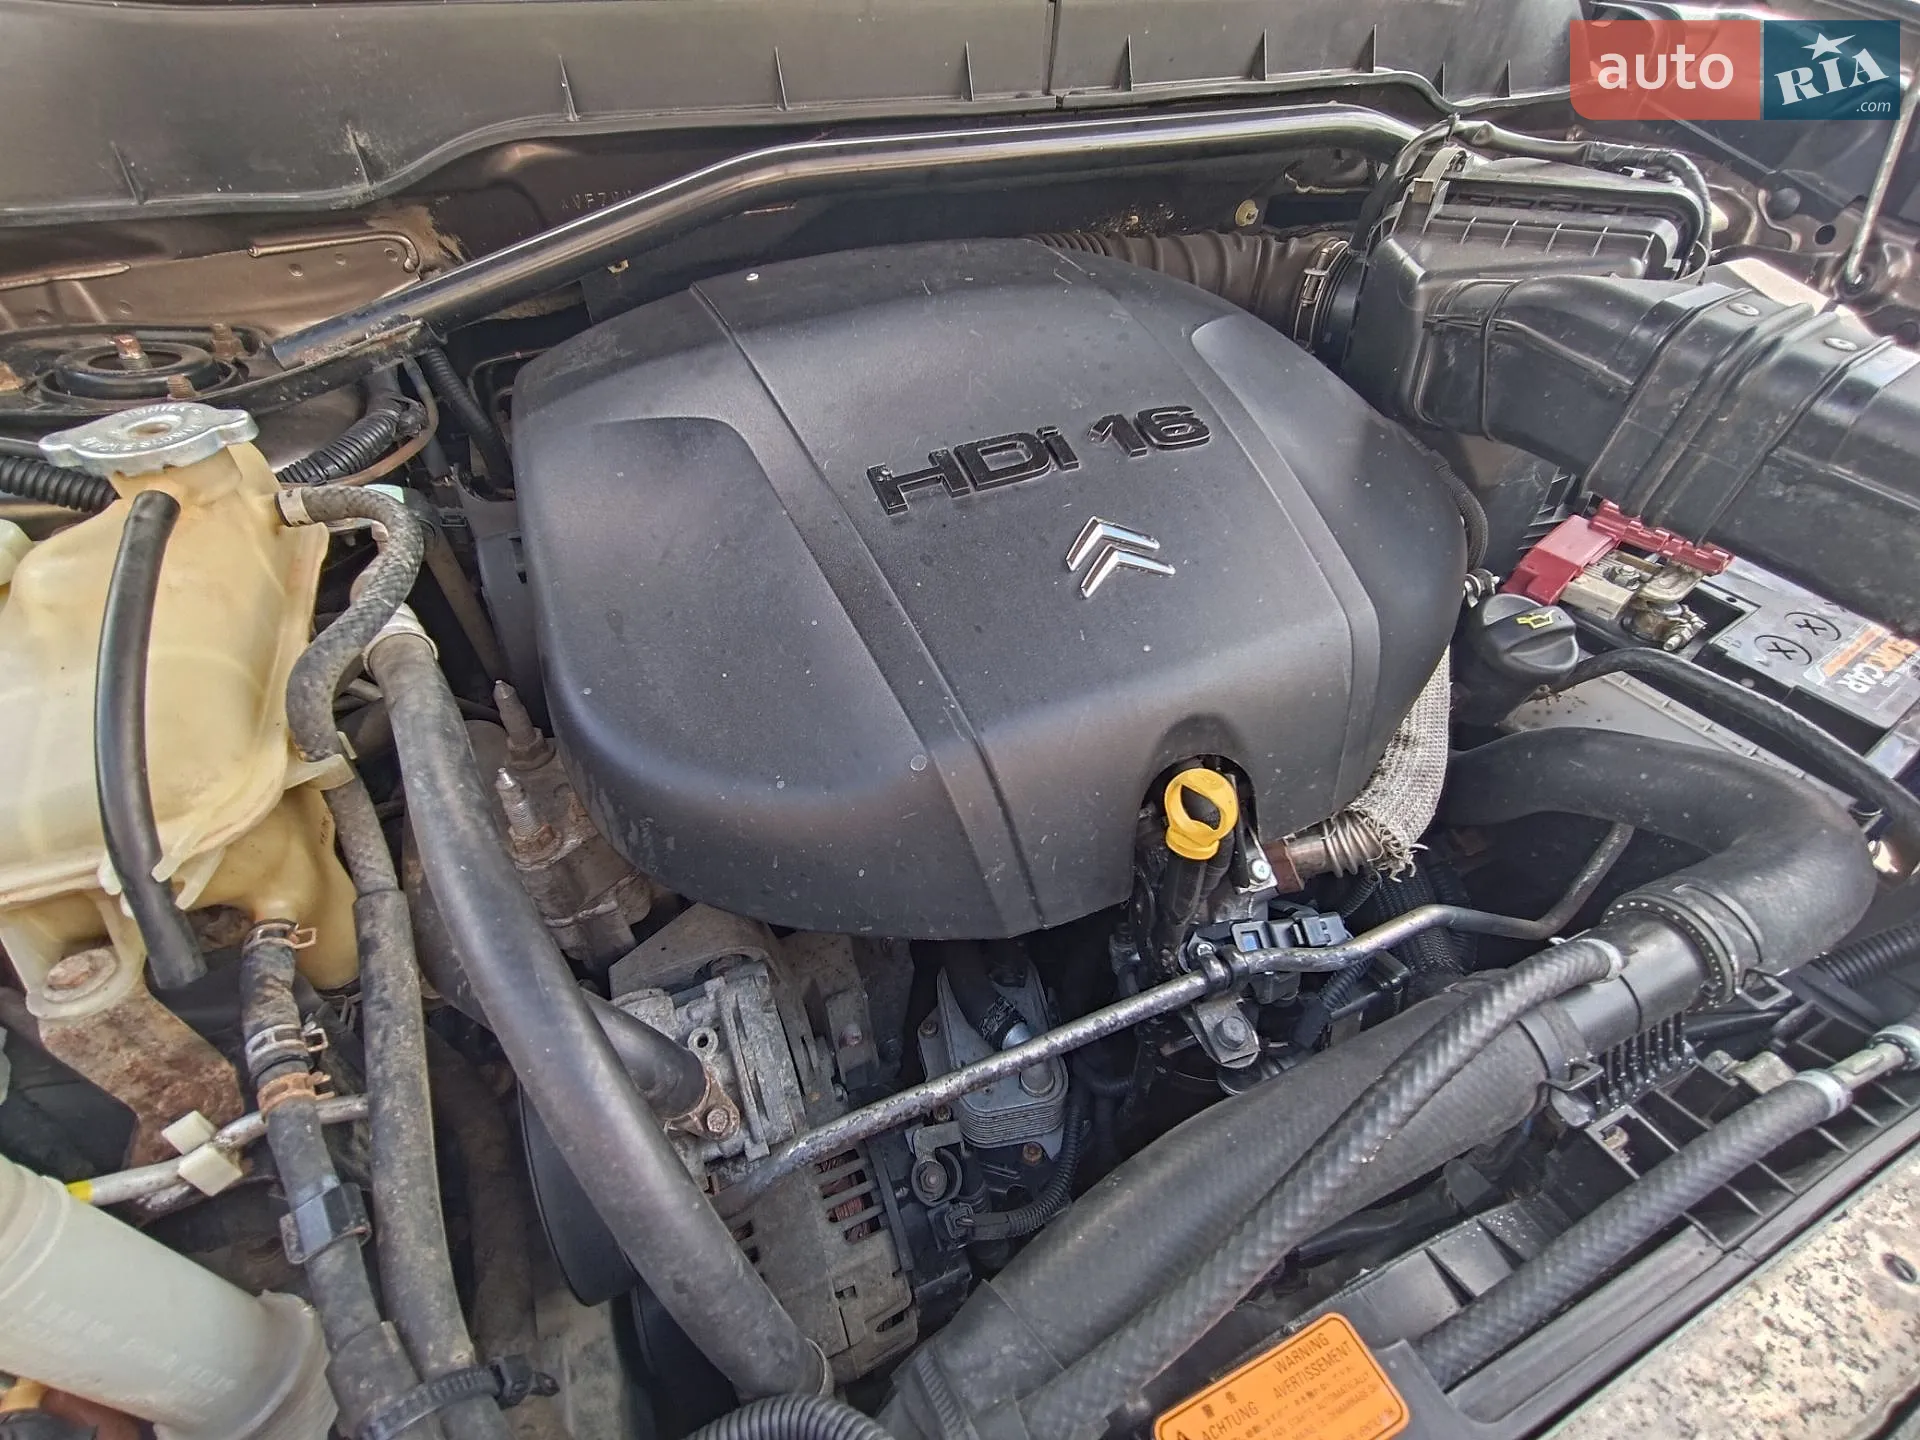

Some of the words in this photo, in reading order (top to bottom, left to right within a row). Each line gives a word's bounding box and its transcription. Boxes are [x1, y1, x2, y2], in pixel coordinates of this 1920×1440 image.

[866, 425, 1080, 516] HDi
[1087, 405, 1211, 458] 16
[1273, 1332, 1330, 1375] WARNING
[1273, 1340, 1352, 1399] AVERTISSEMENT
[1201, 1401, 1259, 1440] ACHTUNG
